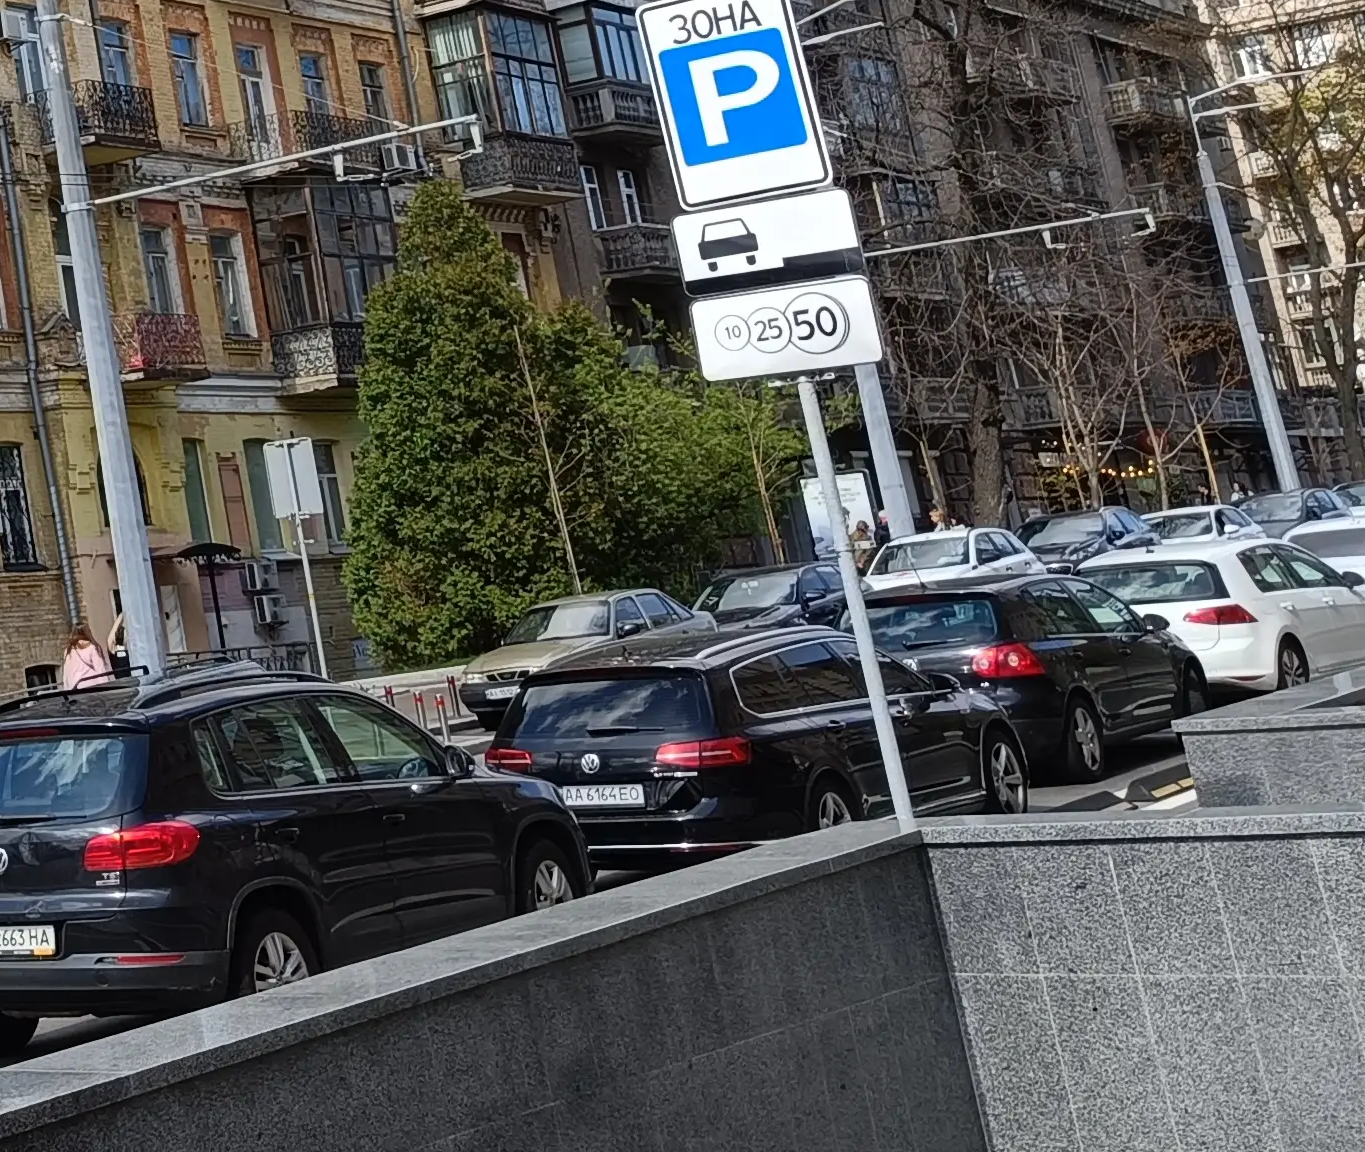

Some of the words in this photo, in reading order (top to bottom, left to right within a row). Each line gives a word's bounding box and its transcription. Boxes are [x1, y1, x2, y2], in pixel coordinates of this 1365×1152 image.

[669, 0, 762, 45] ЗОНА
[687, 48, 781, 147] P
[724, 326, 742, 340] 10
[754, 317, 783, 342] 25
[792, 306, 838, 341] 50
[565, 787, 583, 802] AA
[586, 787, 616, 801] 6164
[619, 786, 639, 801] EO
[28, 928, 50, 946] HA
